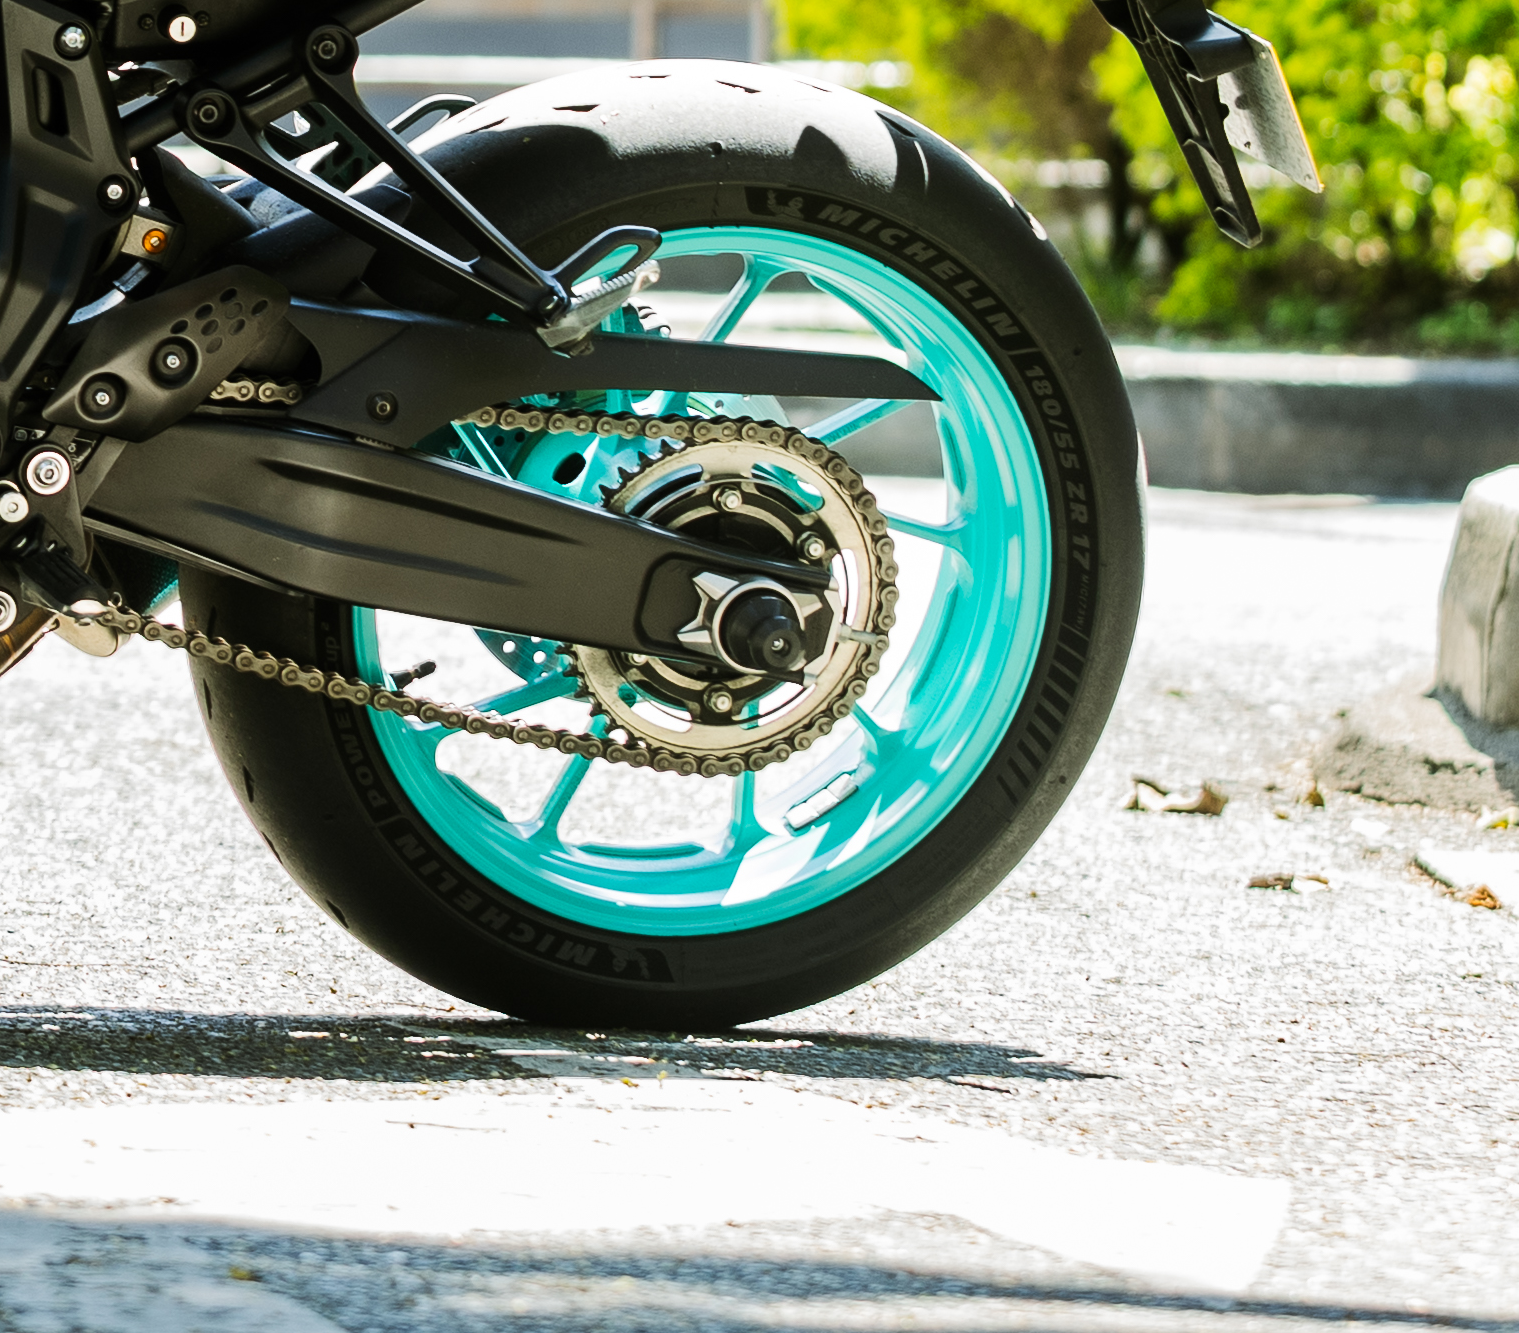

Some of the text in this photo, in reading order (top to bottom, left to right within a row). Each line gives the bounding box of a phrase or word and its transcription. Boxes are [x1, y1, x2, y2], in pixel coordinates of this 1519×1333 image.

[818, 203, 1020, 339] MICHELIN
[1027, 364, 1082, 483] 180/55
[1066, 483, 1090, 526] ZR
[1069, 534, 1093, 573] 17
[395, 832, 598, 967] MICHELIN
